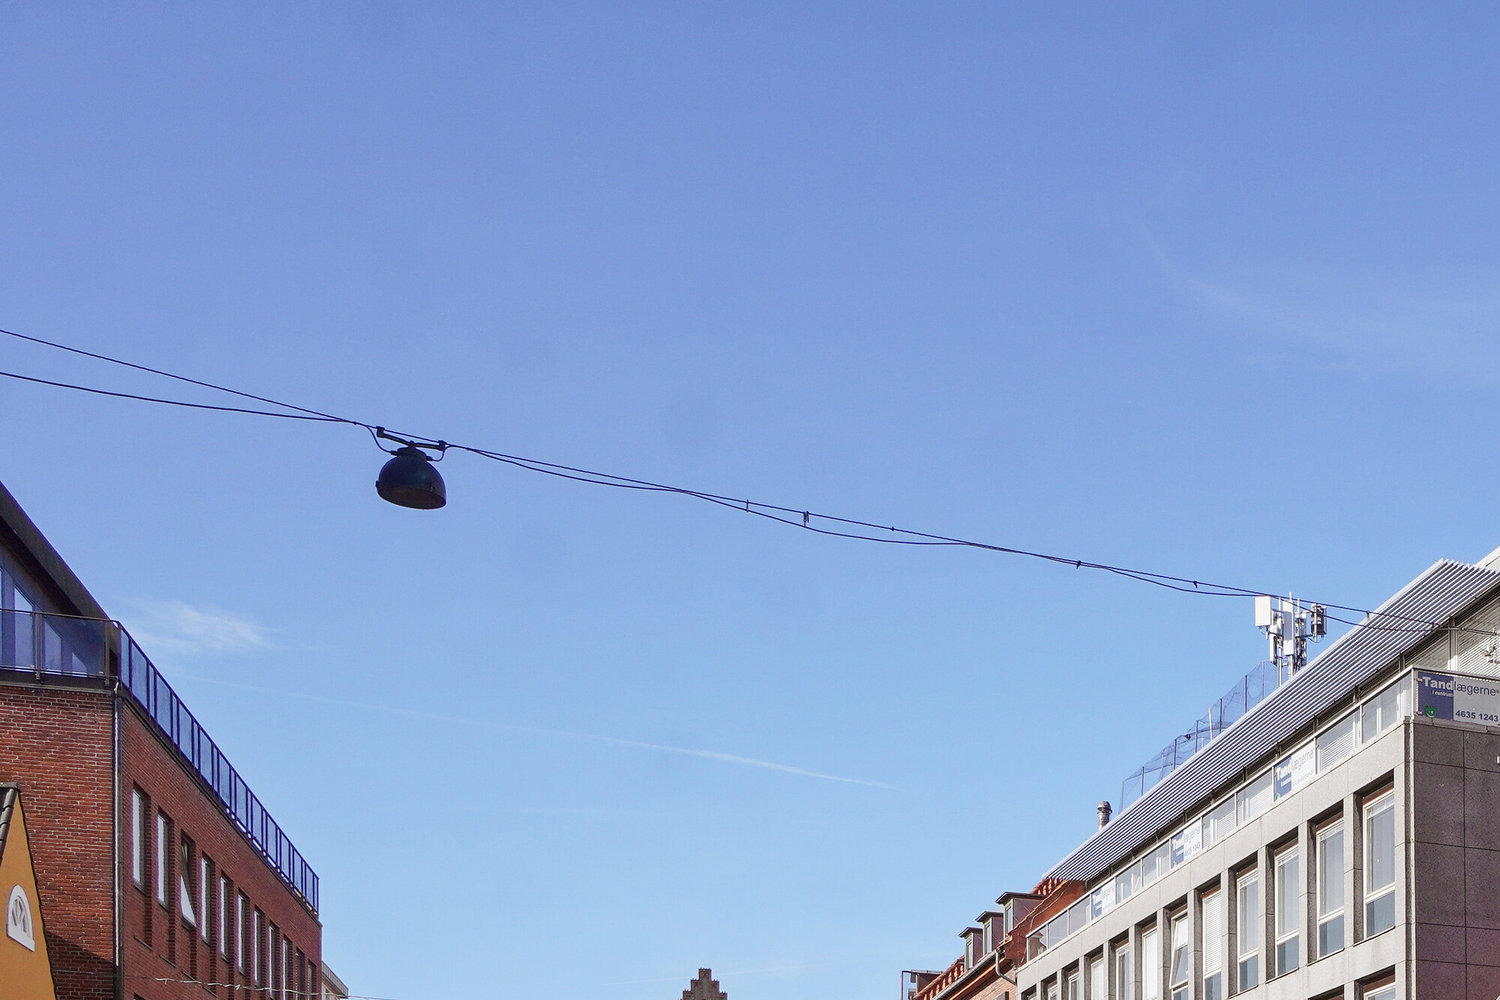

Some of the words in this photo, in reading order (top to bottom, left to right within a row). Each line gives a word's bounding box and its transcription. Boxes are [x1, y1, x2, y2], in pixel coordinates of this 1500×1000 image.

[1421, 676, 1497, 697] Tandlægerne
[1456, 710, 1476, 719] 4635
[1478, 713, 1499, 722] 1243
